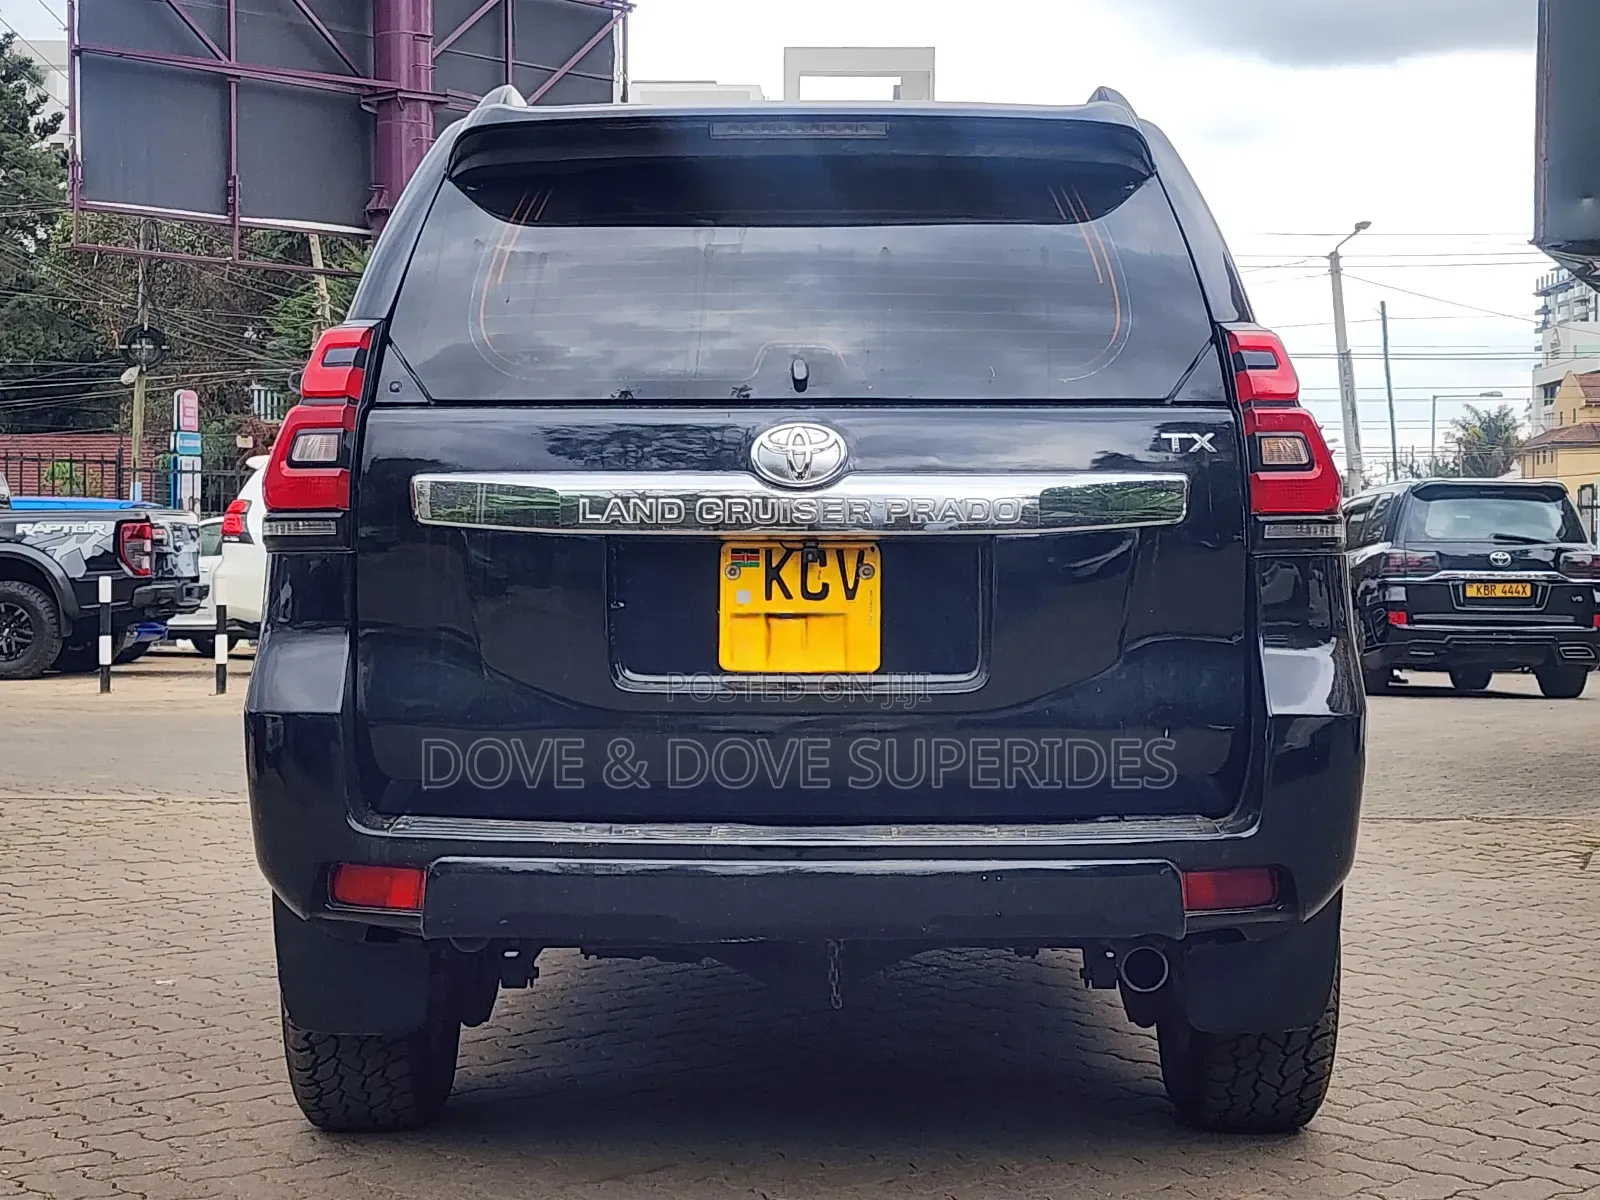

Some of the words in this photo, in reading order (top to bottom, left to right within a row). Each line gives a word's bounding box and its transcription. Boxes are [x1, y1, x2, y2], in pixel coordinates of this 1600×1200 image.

[1160, 432, 1218, 453] TX
[578, 498, 685, 524] LAND
[695, 498, 873, 524] CRUISER
[884, 498, 1021, 524] PRADO
[15, 523, 108, 538] RAPTOR
[764, 548, 867, 601] KCV
[1475, 584, 1497, 596] KBR
[1501, 584, 1528, 596] 444X
